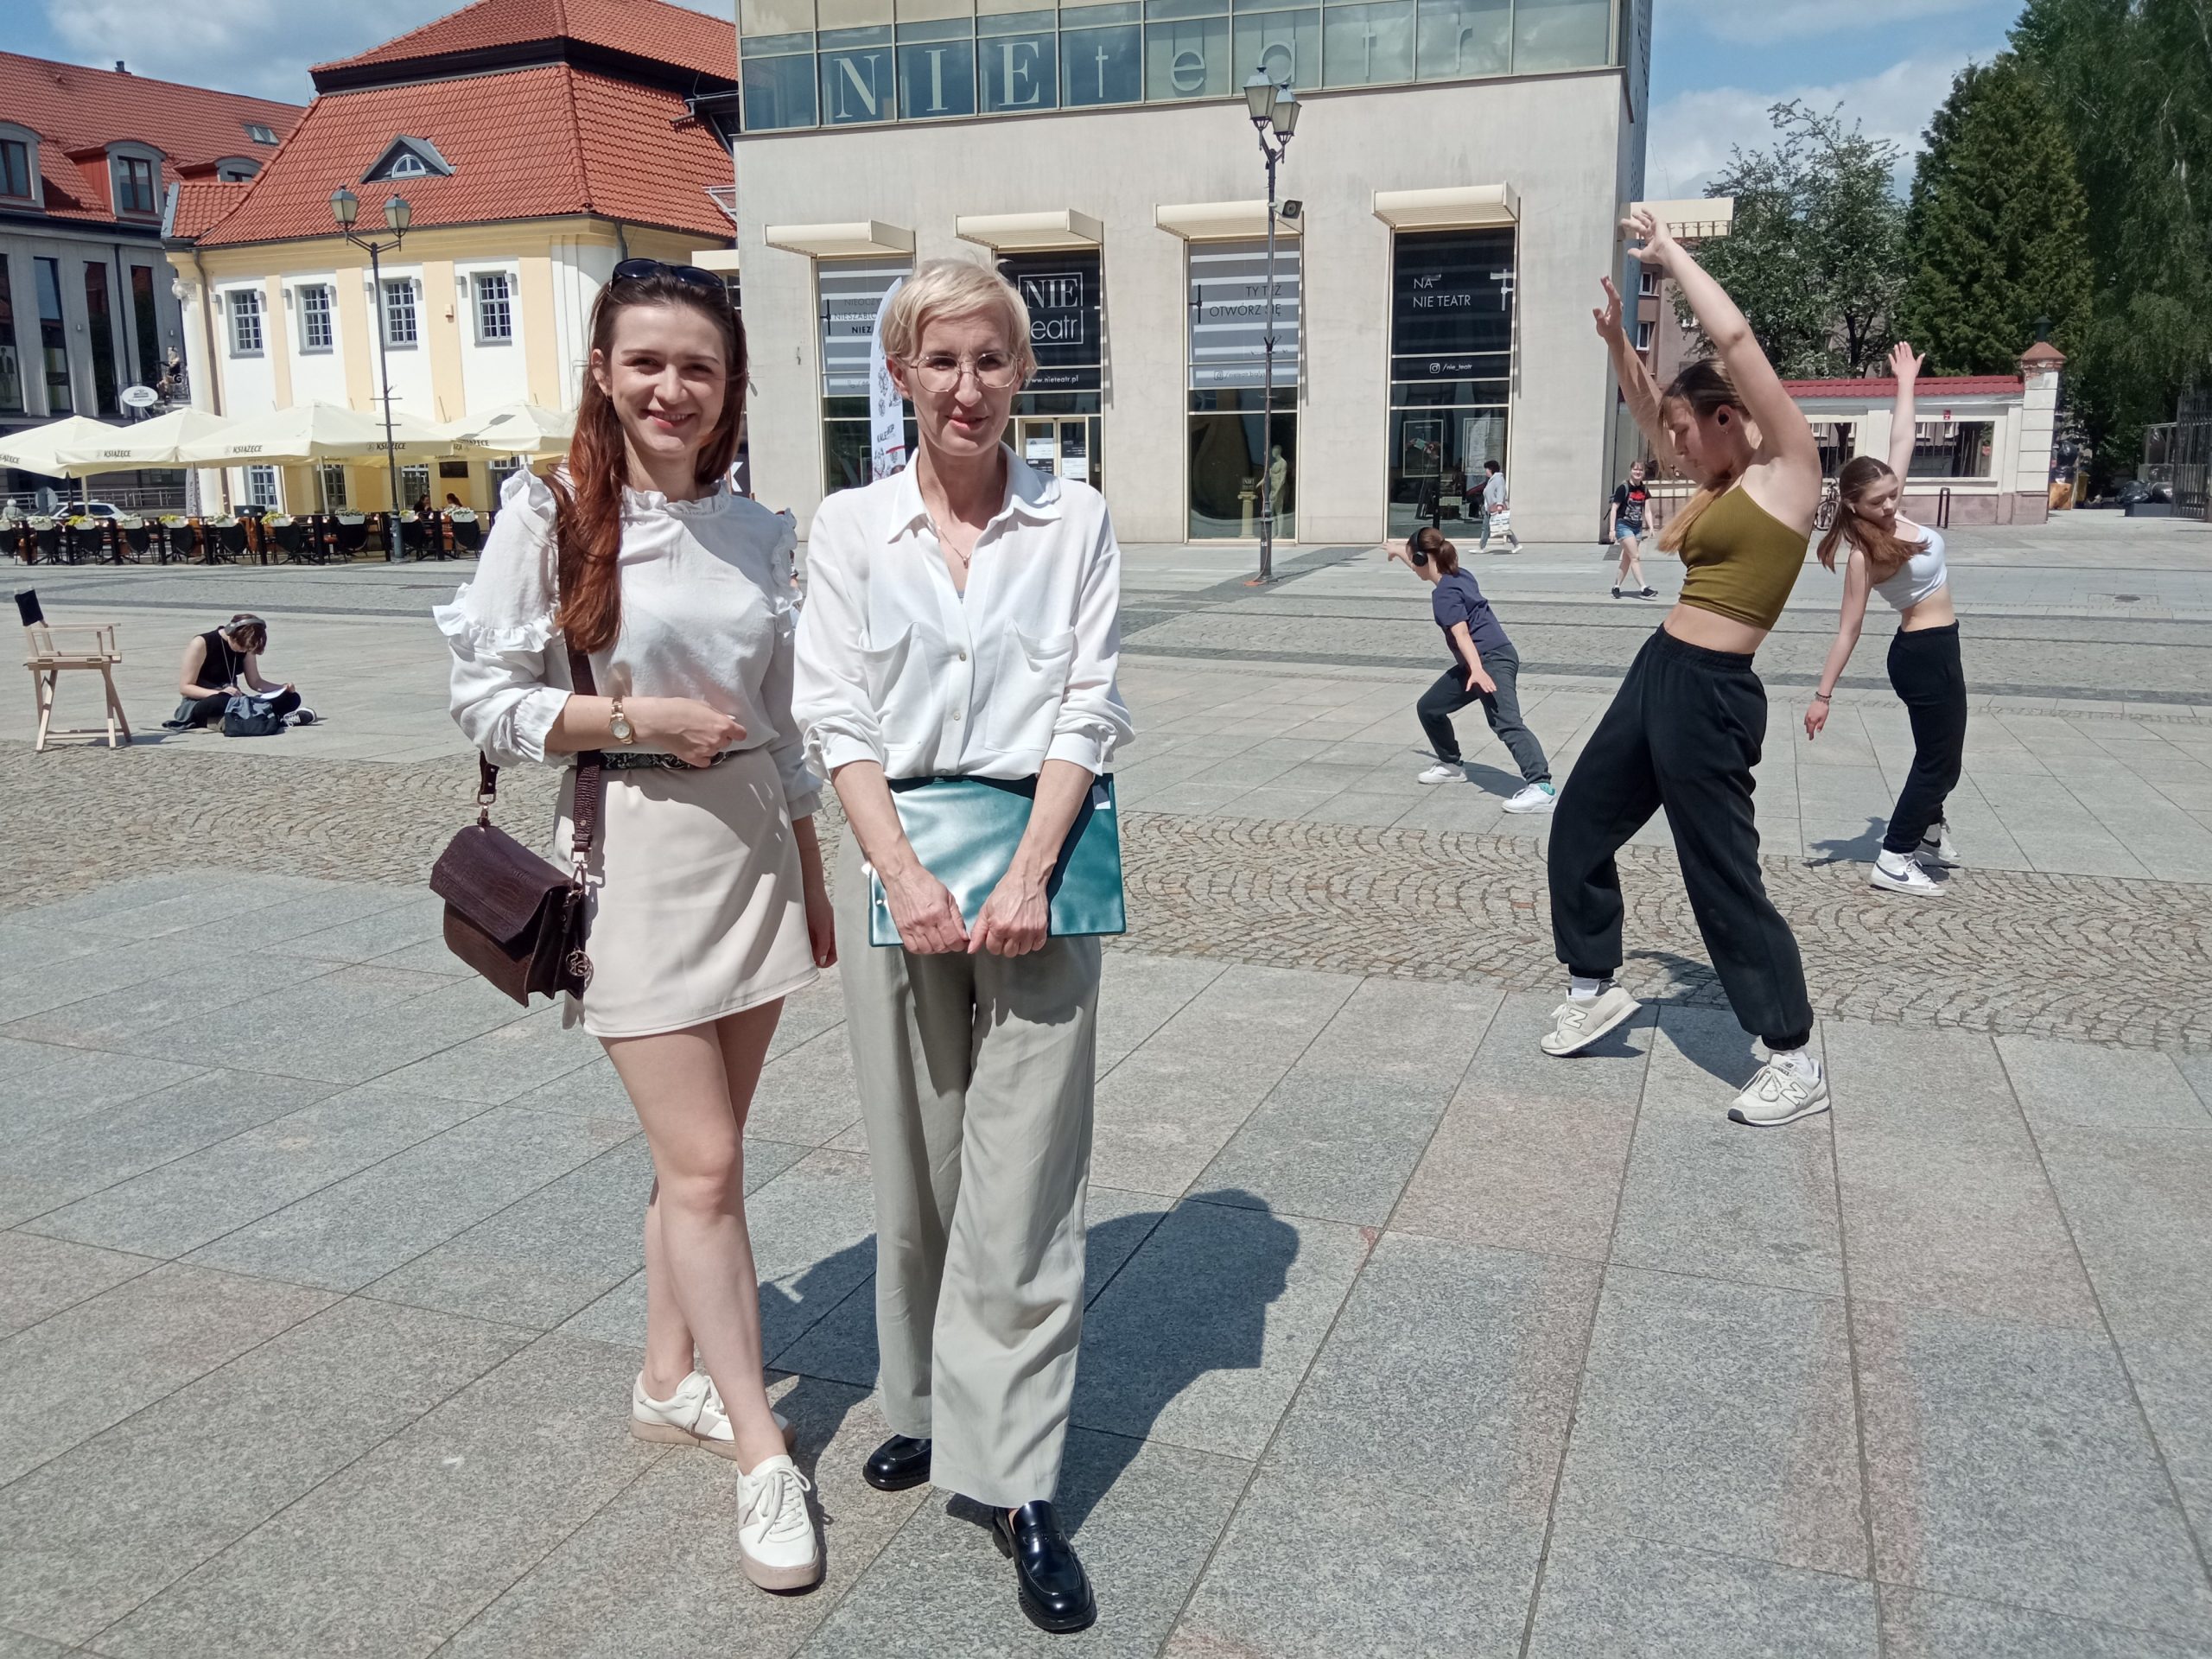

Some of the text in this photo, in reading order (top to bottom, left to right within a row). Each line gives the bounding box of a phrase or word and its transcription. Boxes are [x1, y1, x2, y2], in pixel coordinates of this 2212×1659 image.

[833, 21, 1472, 118] NIE teatr
[1246, 282, 1281, 297] TY TŻ
[1414, 277, 1433, 289] NA
[1023, 278, 1077, 308] NIE
[1414, 295, 1471, 308] NIE TEATR
[1210, 302, 1261, 317] OTWÓRZ
[851, 326, 874, 334] NIEZ
[1030, 315, 1077, 340] eatr
